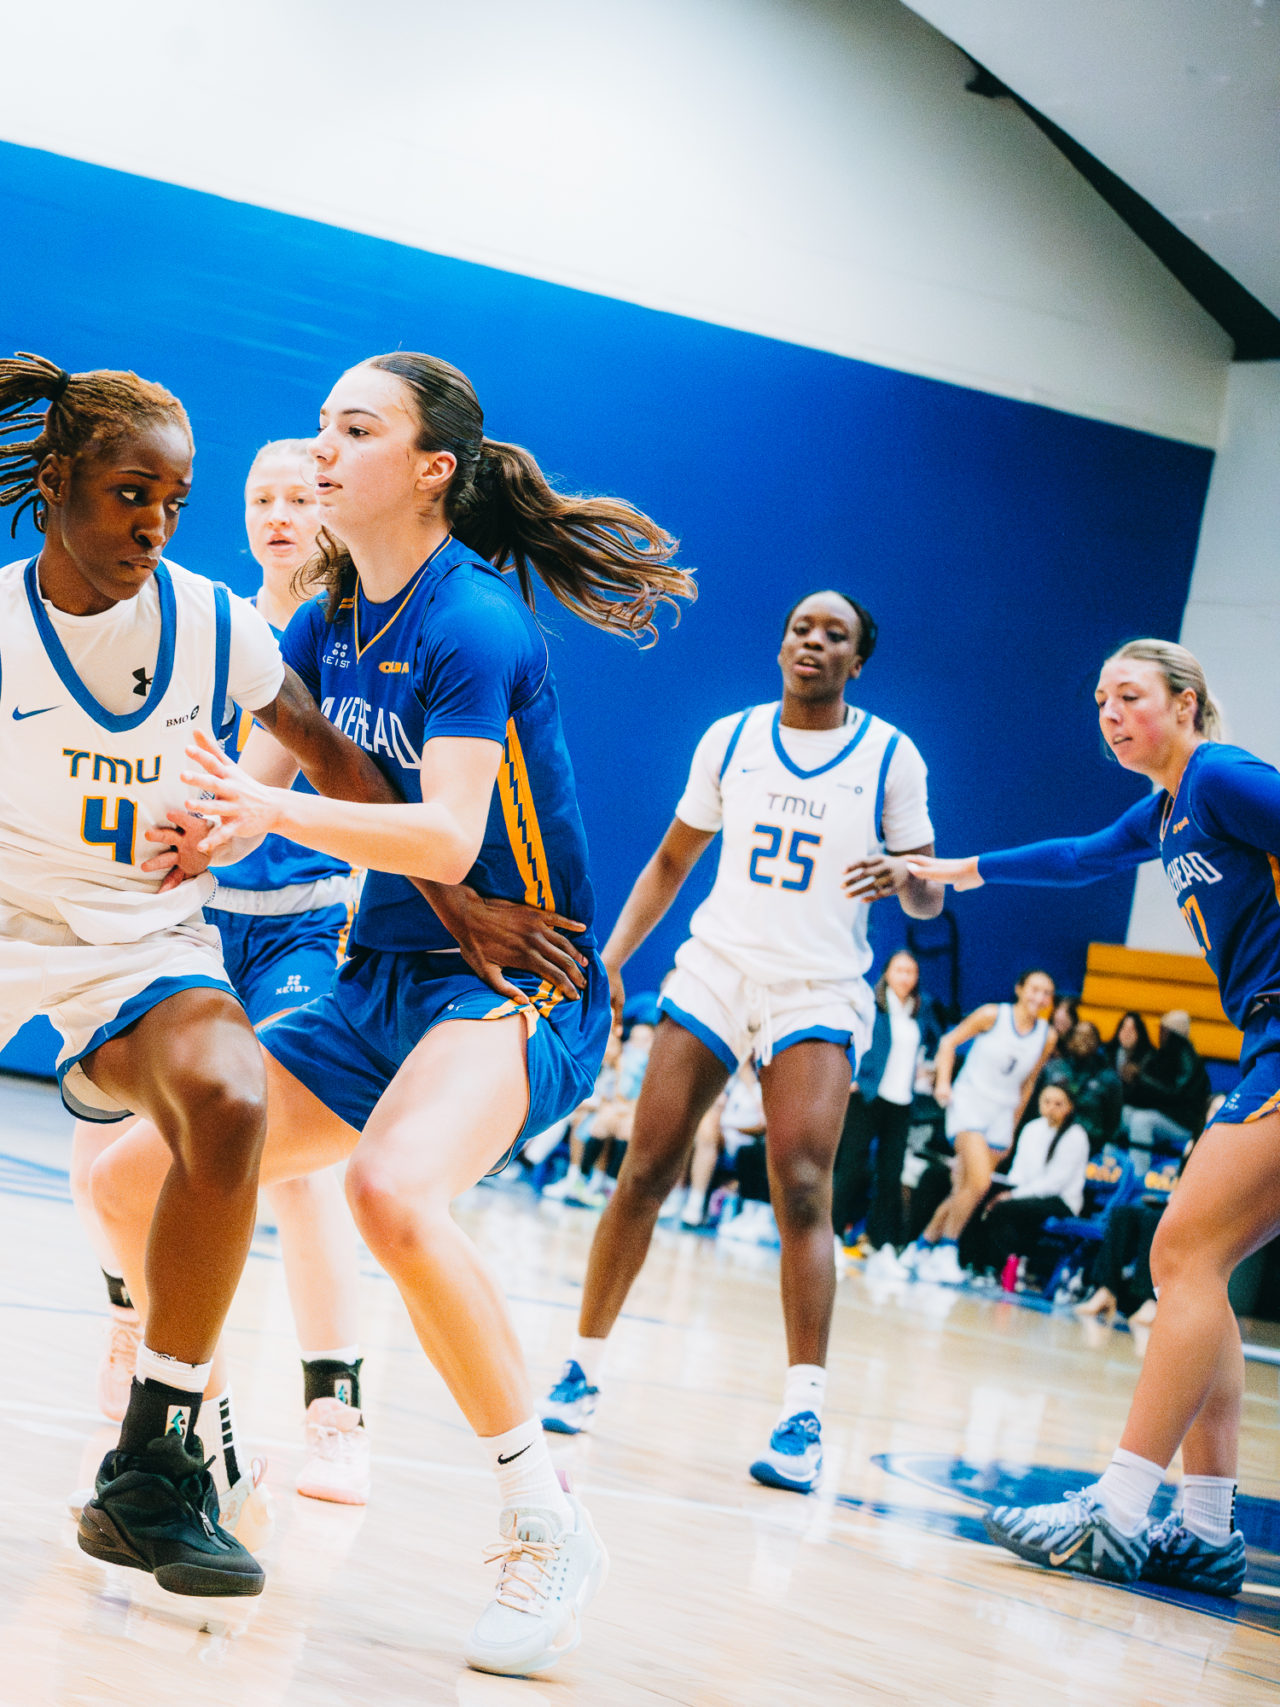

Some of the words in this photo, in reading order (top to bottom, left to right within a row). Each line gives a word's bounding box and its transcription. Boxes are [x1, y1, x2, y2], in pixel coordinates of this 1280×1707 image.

[166, 714, 189, 728] BMO
[62, 747, 162, 785] TMU
[767, 792, 827, 820] TMU
[80, 795, 138, 866] 4
[748, 821, 824, 894] 25
